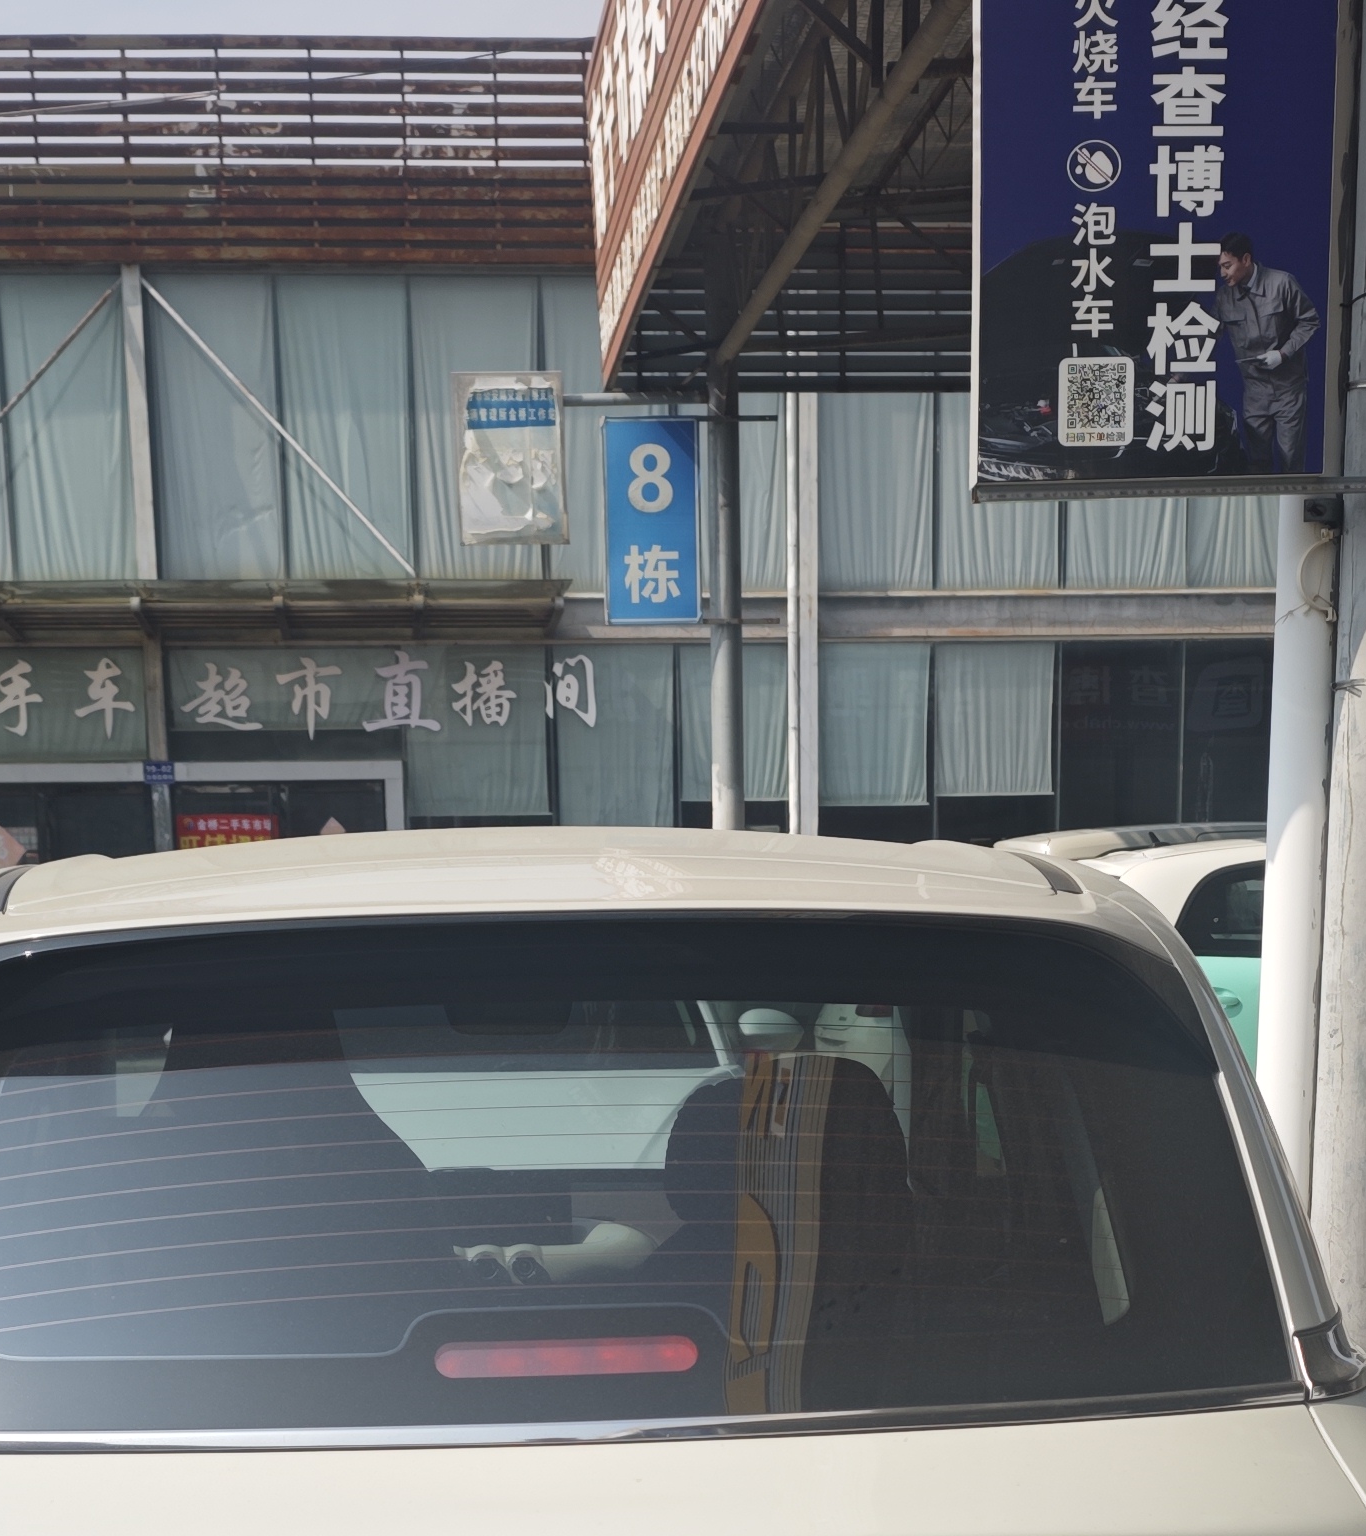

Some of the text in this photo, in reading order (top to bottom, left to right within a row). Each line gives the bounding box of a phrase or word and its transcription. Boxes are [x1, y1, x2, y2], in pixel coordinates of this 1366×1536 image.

[1071, 203, 1117, 338] 泡水车
[1146, 0, 1229, 452] 经查博士检测
[1065, 431, 1126, 443] 扫码下单检测
[624, 442, 681, 604] 8栋
[197, 818, 271, 831] 金桥二手车市场
